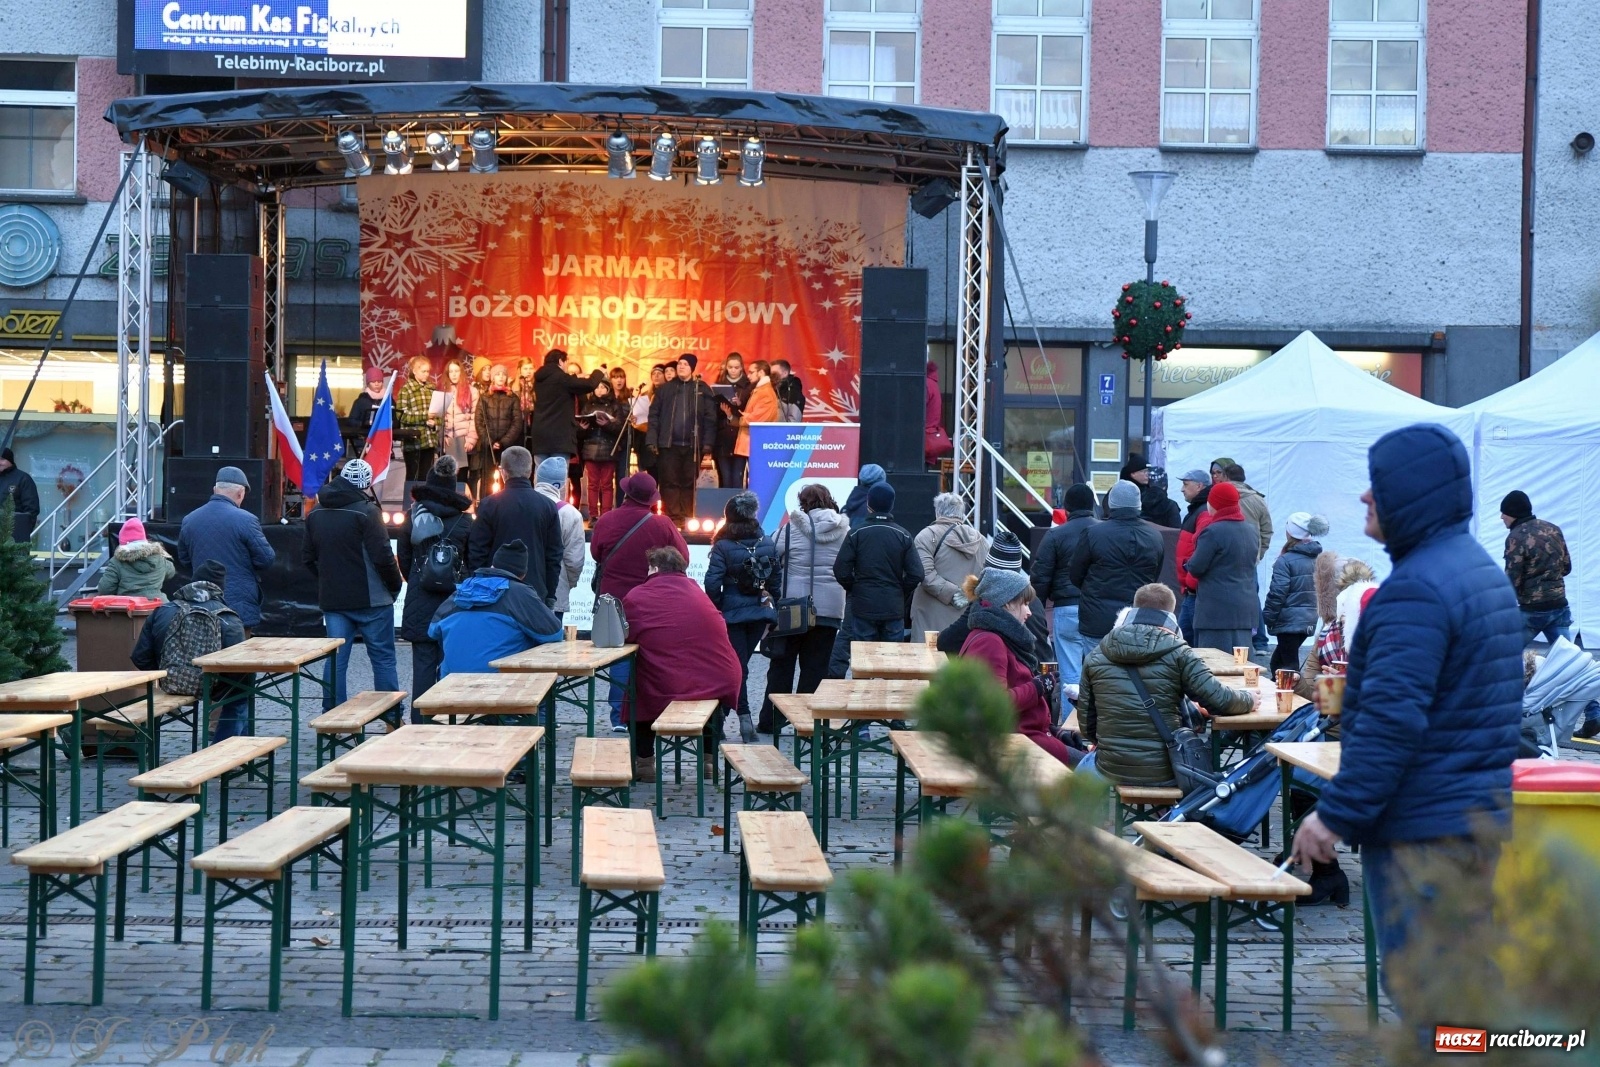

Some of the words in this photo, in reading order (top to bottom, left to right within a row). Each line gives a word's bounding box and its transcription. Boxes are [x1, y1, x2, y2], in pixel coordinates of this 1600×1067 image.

[162, 1, 246, 31] Centrum
[252, 4, 292, 32] Kas
[214, 54, 386, 77] Telebimy-Raciborz.pl
[542, 254, 700, 281] JARMARK
[449, 289, 798, 326] BOŻONARODZENIOWY
[532, 328, 590, 351] Rynek
[594, 333, 611, 348] w
[615, 328, 711, 352] Raciborzu
[1103, 376, 1112, 388] 7
[762, 442, 846, 451] BOŻONARODZENIOWY
[767, 460, 802, 469] VÁNOČNÍ
[803, 461, 840, 469] JARMARK
